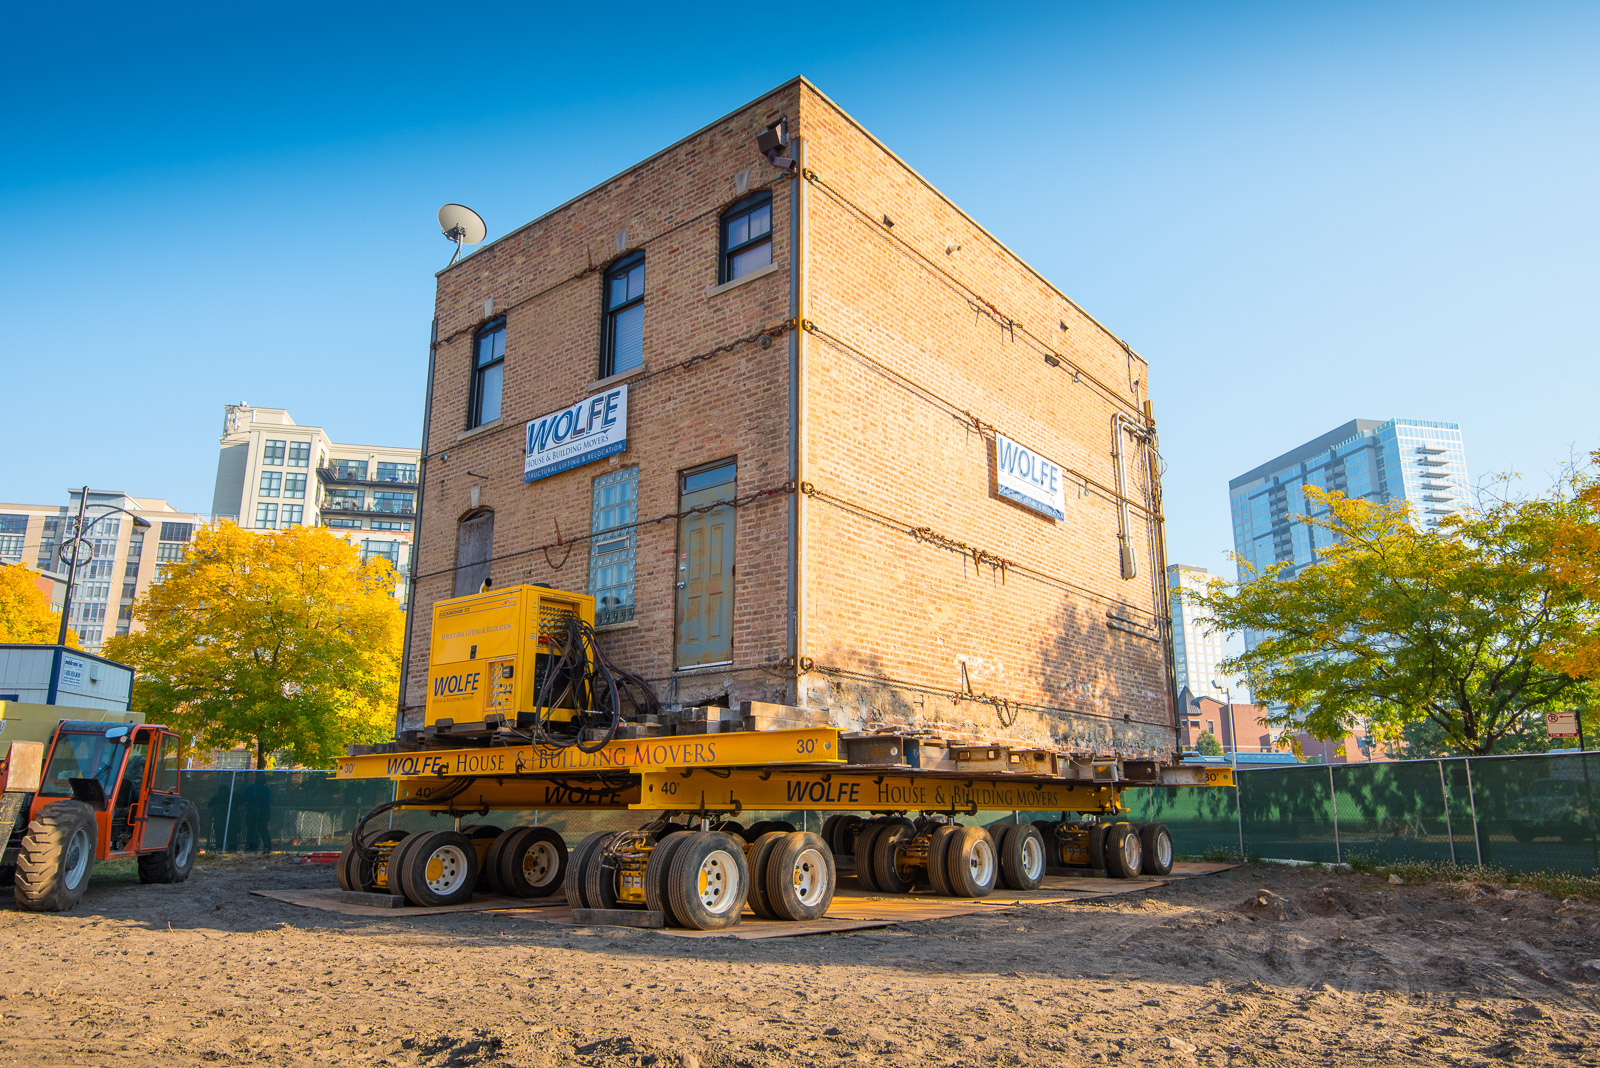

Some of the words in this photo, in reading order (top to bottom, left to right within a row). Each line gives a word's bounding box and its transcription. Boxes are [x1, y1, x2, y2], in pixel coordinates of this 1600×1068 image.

[527, 390, 621, 459] WOLFE
[524, 466, 558, 481] STRUCTURAL
[559, 459, 580, 471] LIFTING
[587, 443, 623, 460] RELOCATION
[526, 456, 545, 469] HOUSE
[545, 454, 551, 462] &
[552, 444, 582, 460] BUILDING
[583, 434, 609, 450] MOVERS
[998, 437, 1059, 494] WOLFE
[441, 631, 465, 640] STRUCTURAL
[465, 628, 482, 637] LIFTING
[486, 624, 512, 633] RELOCATION
[433, 672, 480, 698] WOLFE
[387, 756, 442, 775] WOLFE
[456, 753, 505, 772] HOUSE
[515, 750, 528, 770] &
[539, 748, 626, 769] BUILDING
[633, 742, 716, 766] MOVERS
[796, 738, 819, 754] 30'
[545, 786, 621, 804] WOLFE
[661, 781, 680, 795] 40'
[787, 781, 860, 802] WOLFE
[877, 783, 926, 804] HOUSE
[935, 785, 947, 804] &
[953, 785, 1013, 806] BUILDING
[1017, 787, 1058, 807] MOVERS
